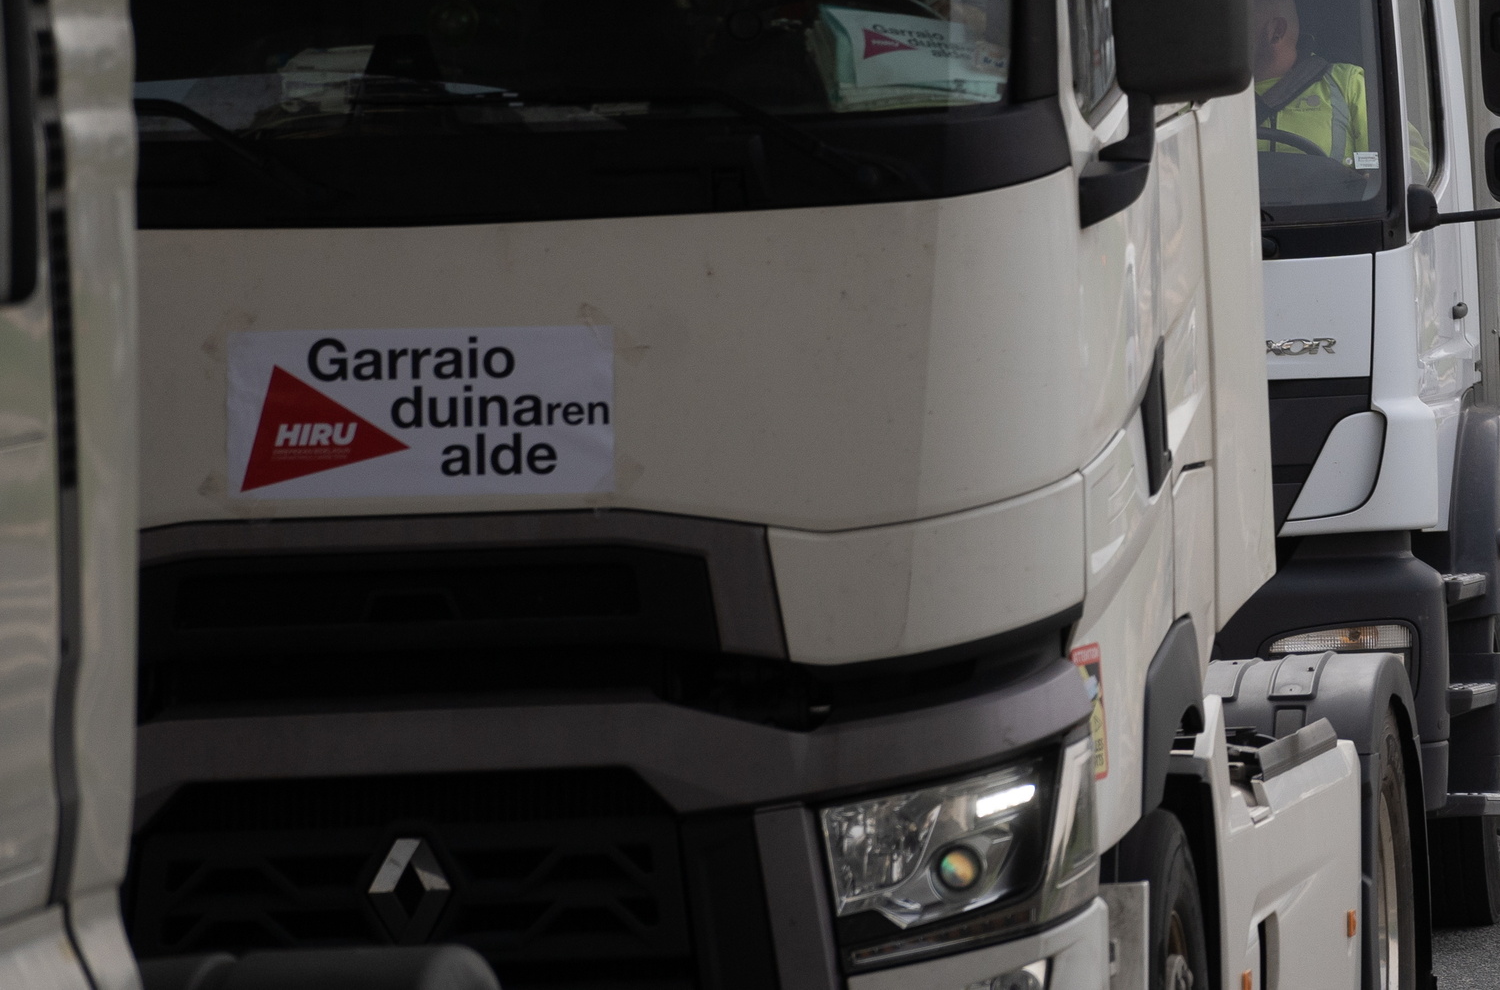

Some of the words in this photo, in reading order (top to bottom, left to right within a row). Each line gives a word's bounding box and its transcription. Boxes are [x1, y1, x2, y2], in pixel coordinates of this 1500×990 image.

[307, 336, 515, 382] Garraio
[1265, 337, 1337, 356] XOR
[390, 385, 610, 429] duinaren
[275, 422, 358, 447] HIRU
[441, 433, 558, 477] alde
